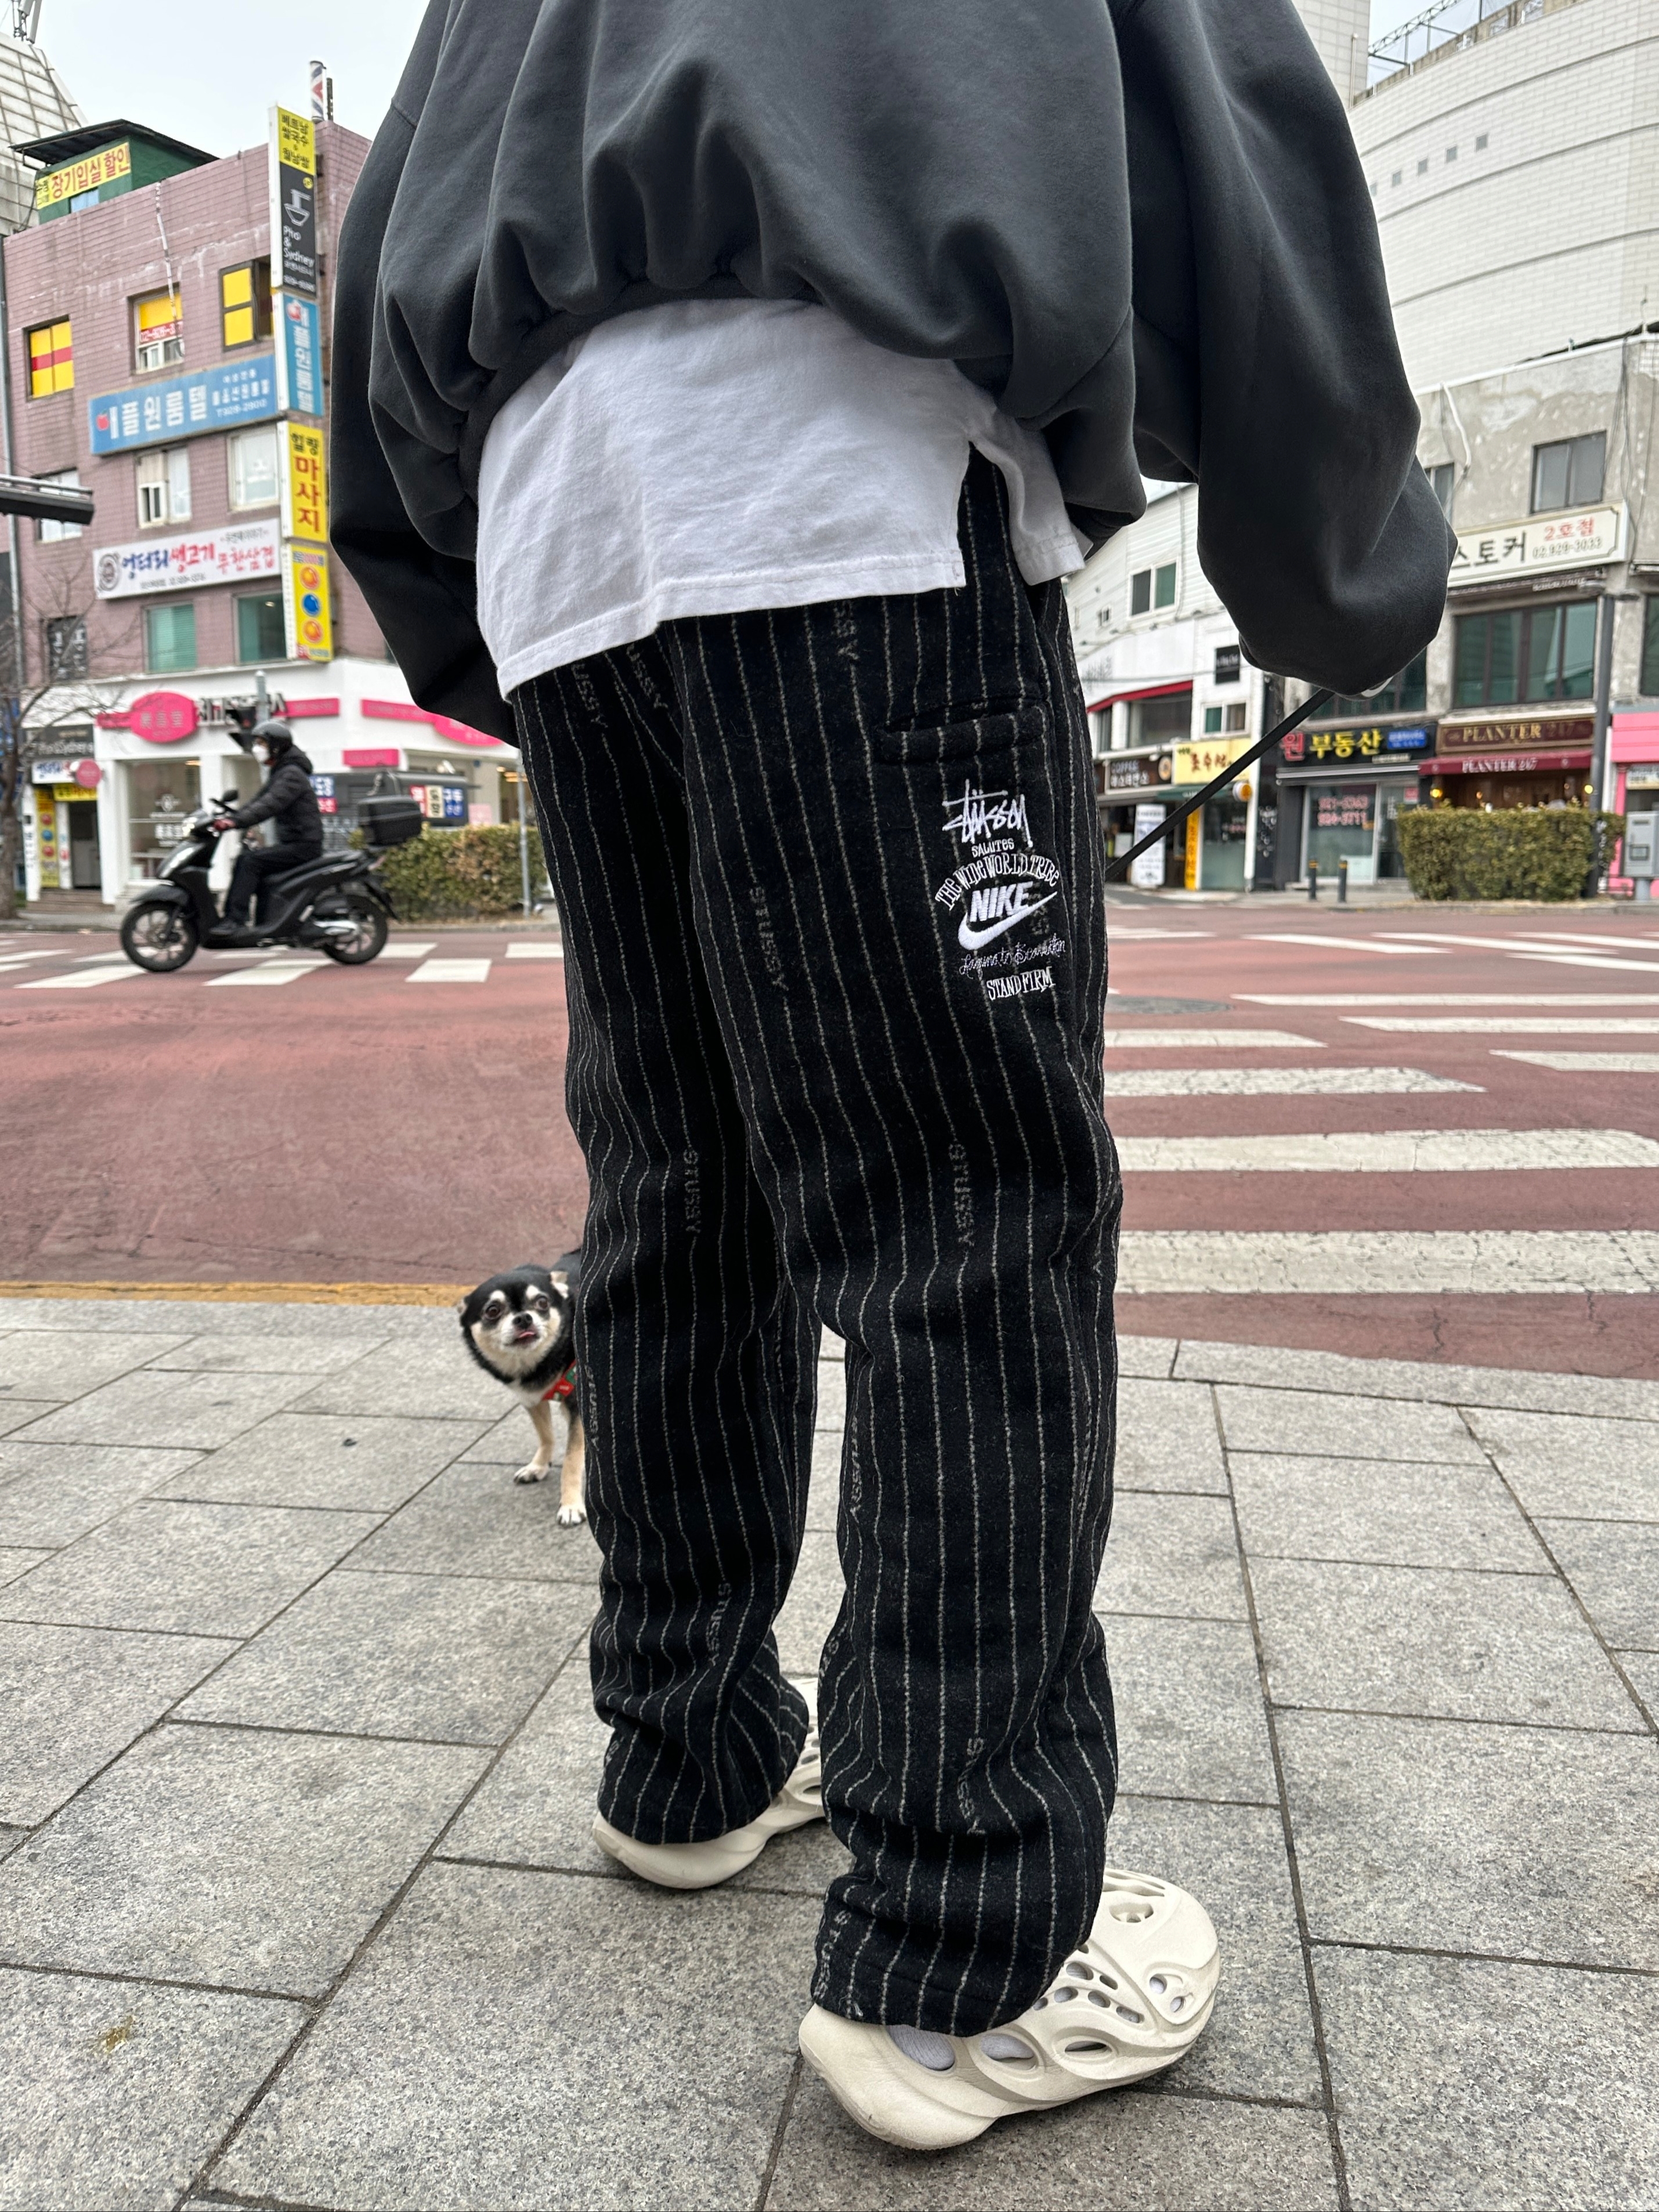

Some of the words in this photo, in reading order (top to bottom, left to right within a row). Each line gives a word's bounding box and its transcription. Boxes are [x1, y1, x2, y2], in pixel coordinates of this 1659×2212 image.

[51, 157, 102, 200] 장기입실
[103, 144, 130, 178] 할인
[283, 247, 315, 269] Sydney
[291, 432, 320, 457] 힐링
[294, 455, 320, 533] 마사지
[1544, 517, 1595, 542] 2호점
[1309, 729, 1382, 760] 부동산
[1462, 723, 1542, 743] PLANTER
[1462, 758, 1517, 773] PLANTER
[982, 852, 1028, 878] WORLD
[969, 881, 1033, 922] NIKE
[986, 975, 1021, 1001] STAND
[1020, 966, 1056, 993] FIRM
